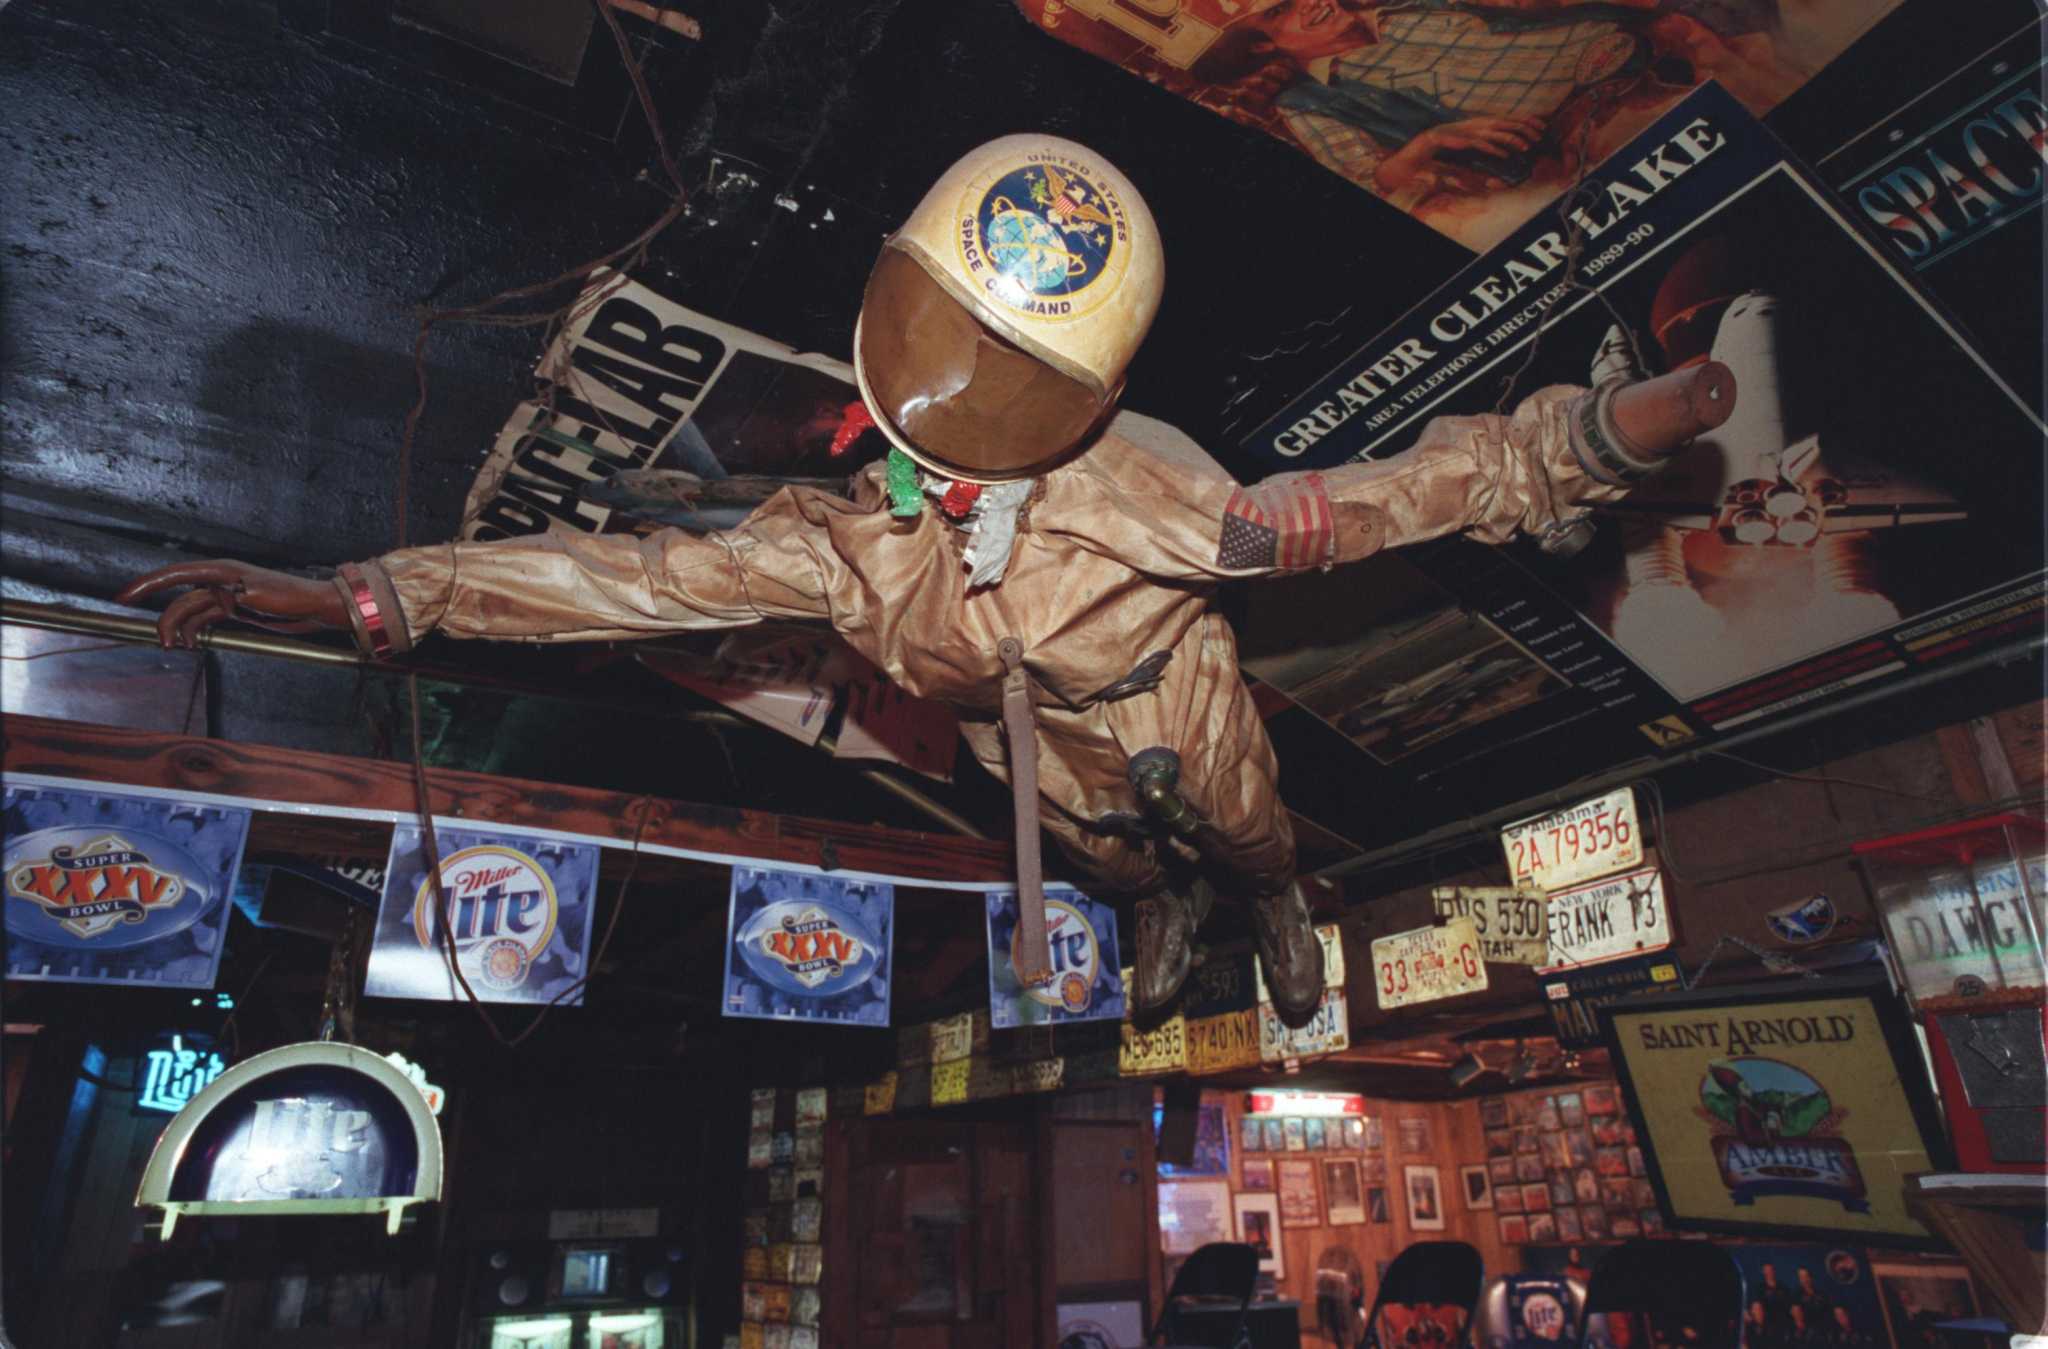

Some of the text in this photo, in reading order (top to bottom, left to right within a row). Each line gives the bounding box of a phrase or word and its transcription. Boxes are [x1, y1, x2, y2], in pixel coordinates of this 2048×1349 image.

[1027, 154, 1127, 242] UNITED STATES
[962, 218, 1072, 315] SPACE CMAND
[1273, 117, 1727, 457] GREATER CLEAR LAKE
[1364, 222, 1656, 431] AREA TELEPHONE DIRECTOR 1989-90
[73, 853, 131, 868] SUPER
[1511, 808, 1630, 876] 2A 79356
[24, 865, 171, 906] XXXV
[455, 865, 524, 894] Miller
[1558, 884, 1624, 908] NEW YORK
[69, 901, 123, 918] BOWL
[795, 921, 829, 934] SUPER
[1498, 898, 1540, 936] 530
[1548, 898, 1614, 951] FRANK
[771, 930, 853, 963] XXXV
[799, 959, 829, 971] BOWL
[1640, 1015, 1855, 1057] SAINT ARNOLD
[1726, 1143, 1845, 1173] AMBER
